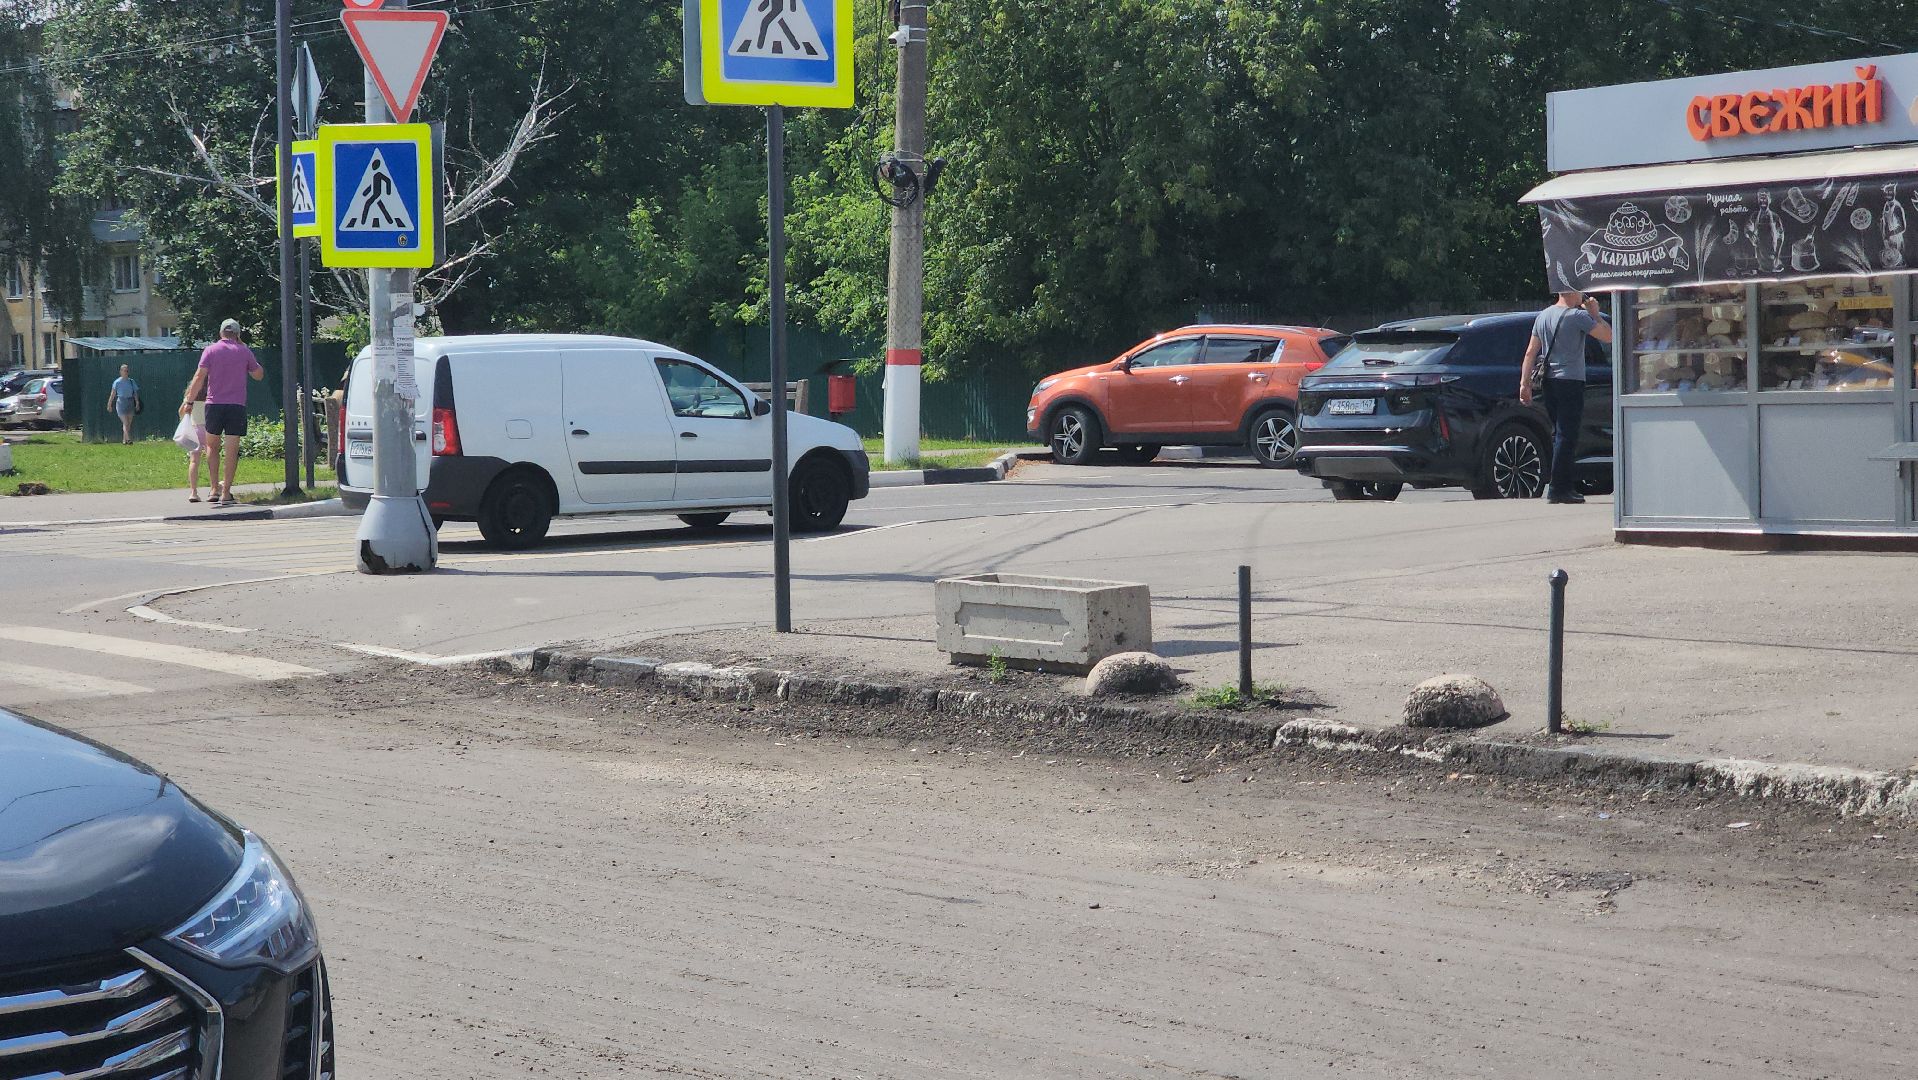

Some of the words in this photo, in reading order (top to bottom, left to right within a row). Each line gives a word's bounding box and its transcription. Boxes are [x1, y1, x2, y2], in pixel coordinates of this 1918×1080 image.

[1686, 65, 1882, 142] СВЕЖИЙ
[1706, 193, 1743, 208] Ручная
[1720, 204, 1749, 216] работа
